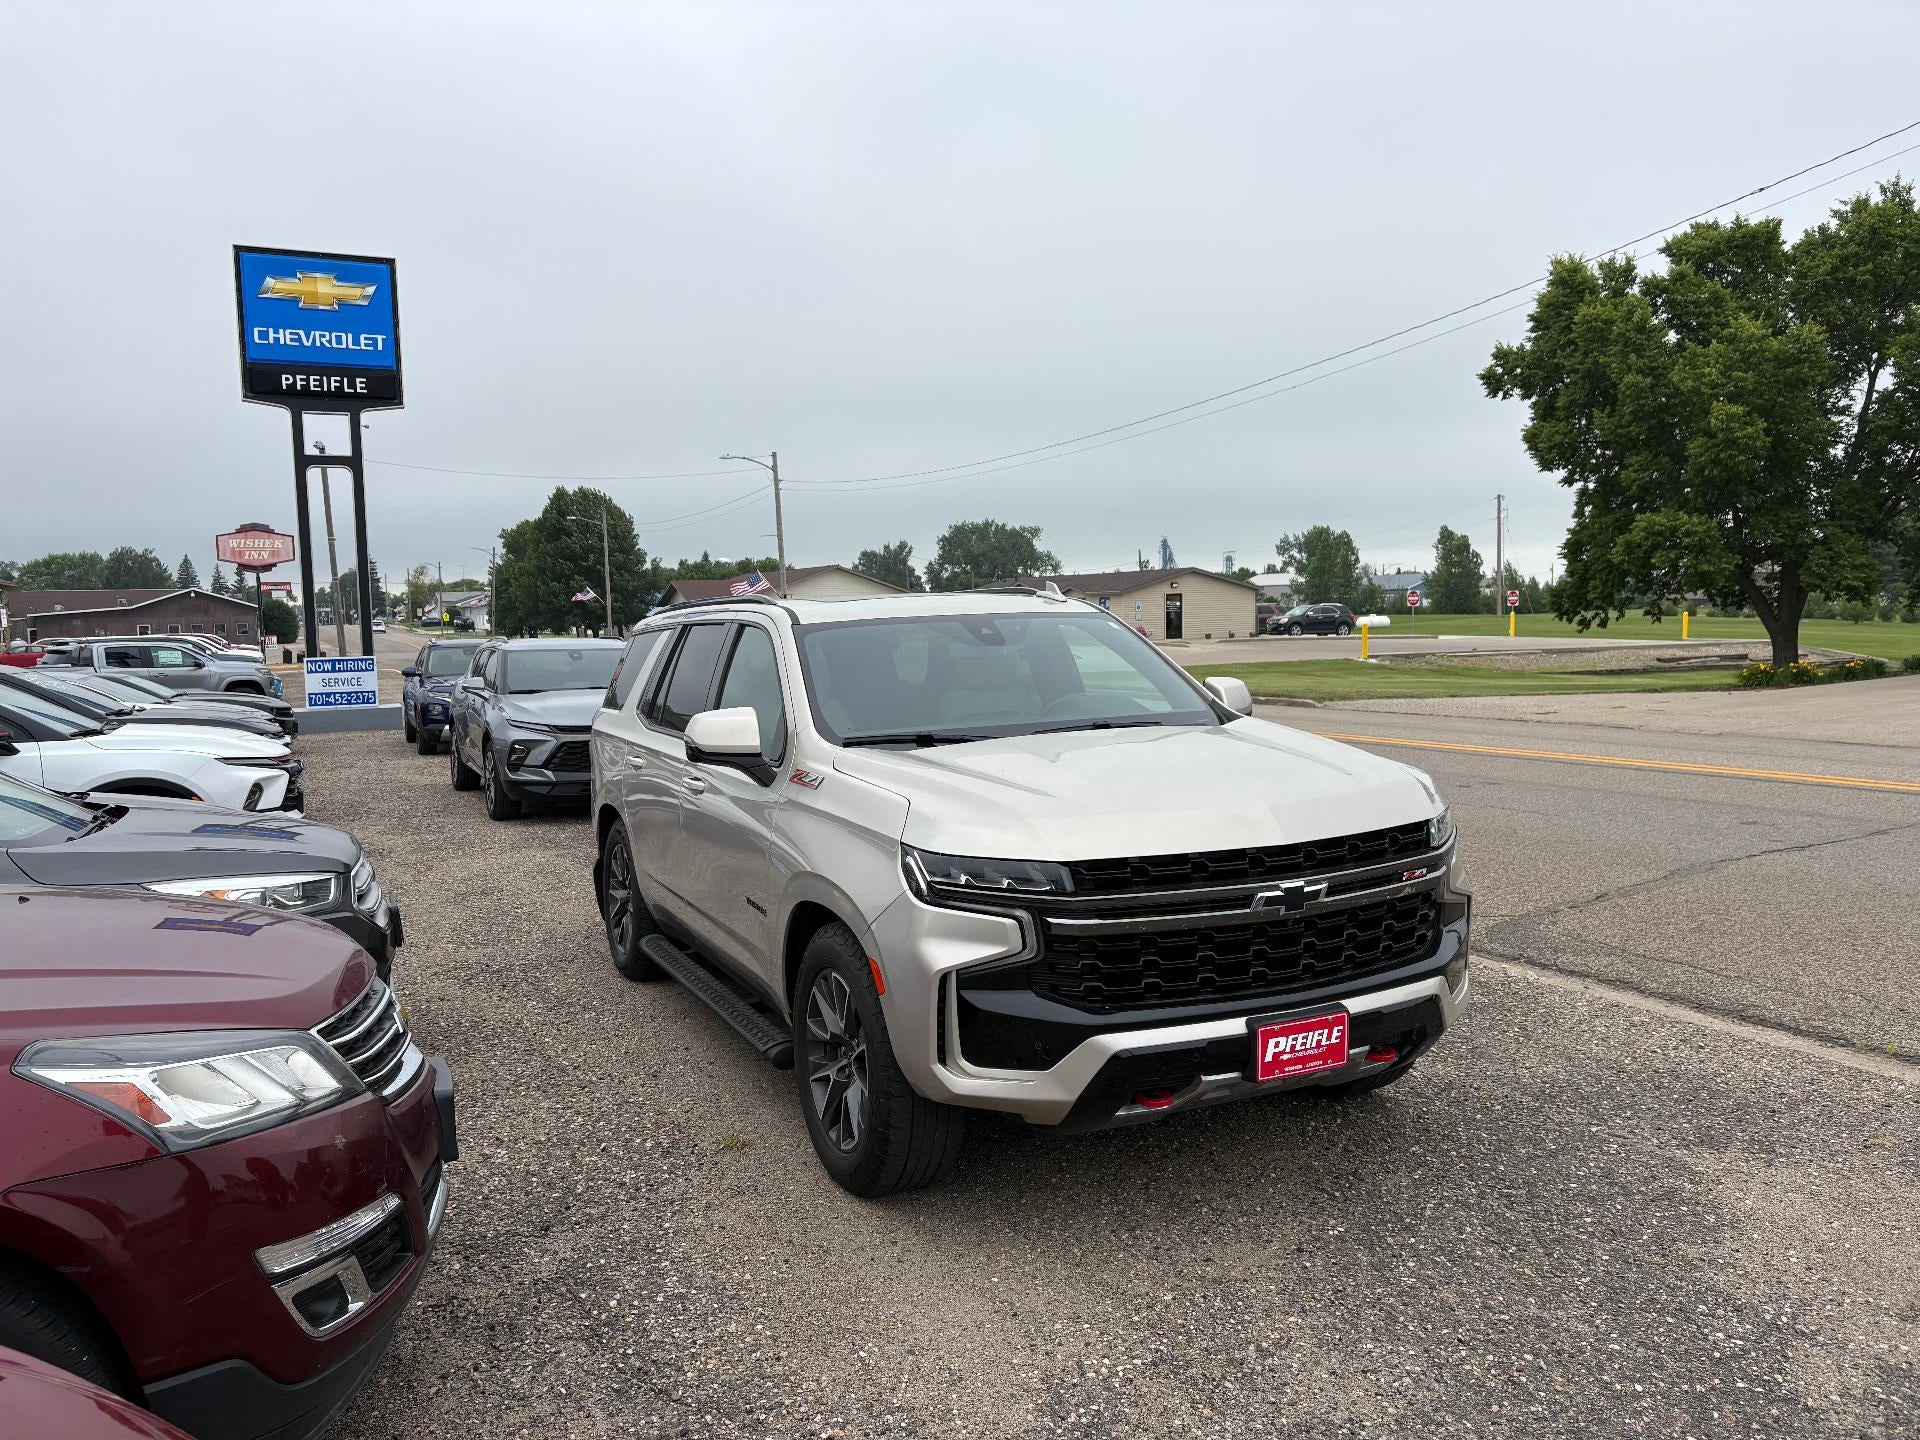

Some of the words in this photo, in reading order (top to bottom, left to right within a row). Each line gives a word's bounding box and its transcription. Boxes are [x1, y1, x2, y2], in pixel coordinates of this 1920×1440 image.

[253, 327, 386, 351] CHEVROLET
[281, 374, 367, 393] PFEIFLE
[228, 538, 283, 548] WISHEK
[244, 550, 270, 560] INN
[307, 661, 332, 672] NOW
[335, 660, 373, 671] HIRING
[321, 677, 363, 688] SERVICE
[309, 692, 375, 705] 701-452-2375
[1263, 1025, 1344, 1063] PFEIFLE
[1290, 1046, 1328, 1058] CHEVROLET
